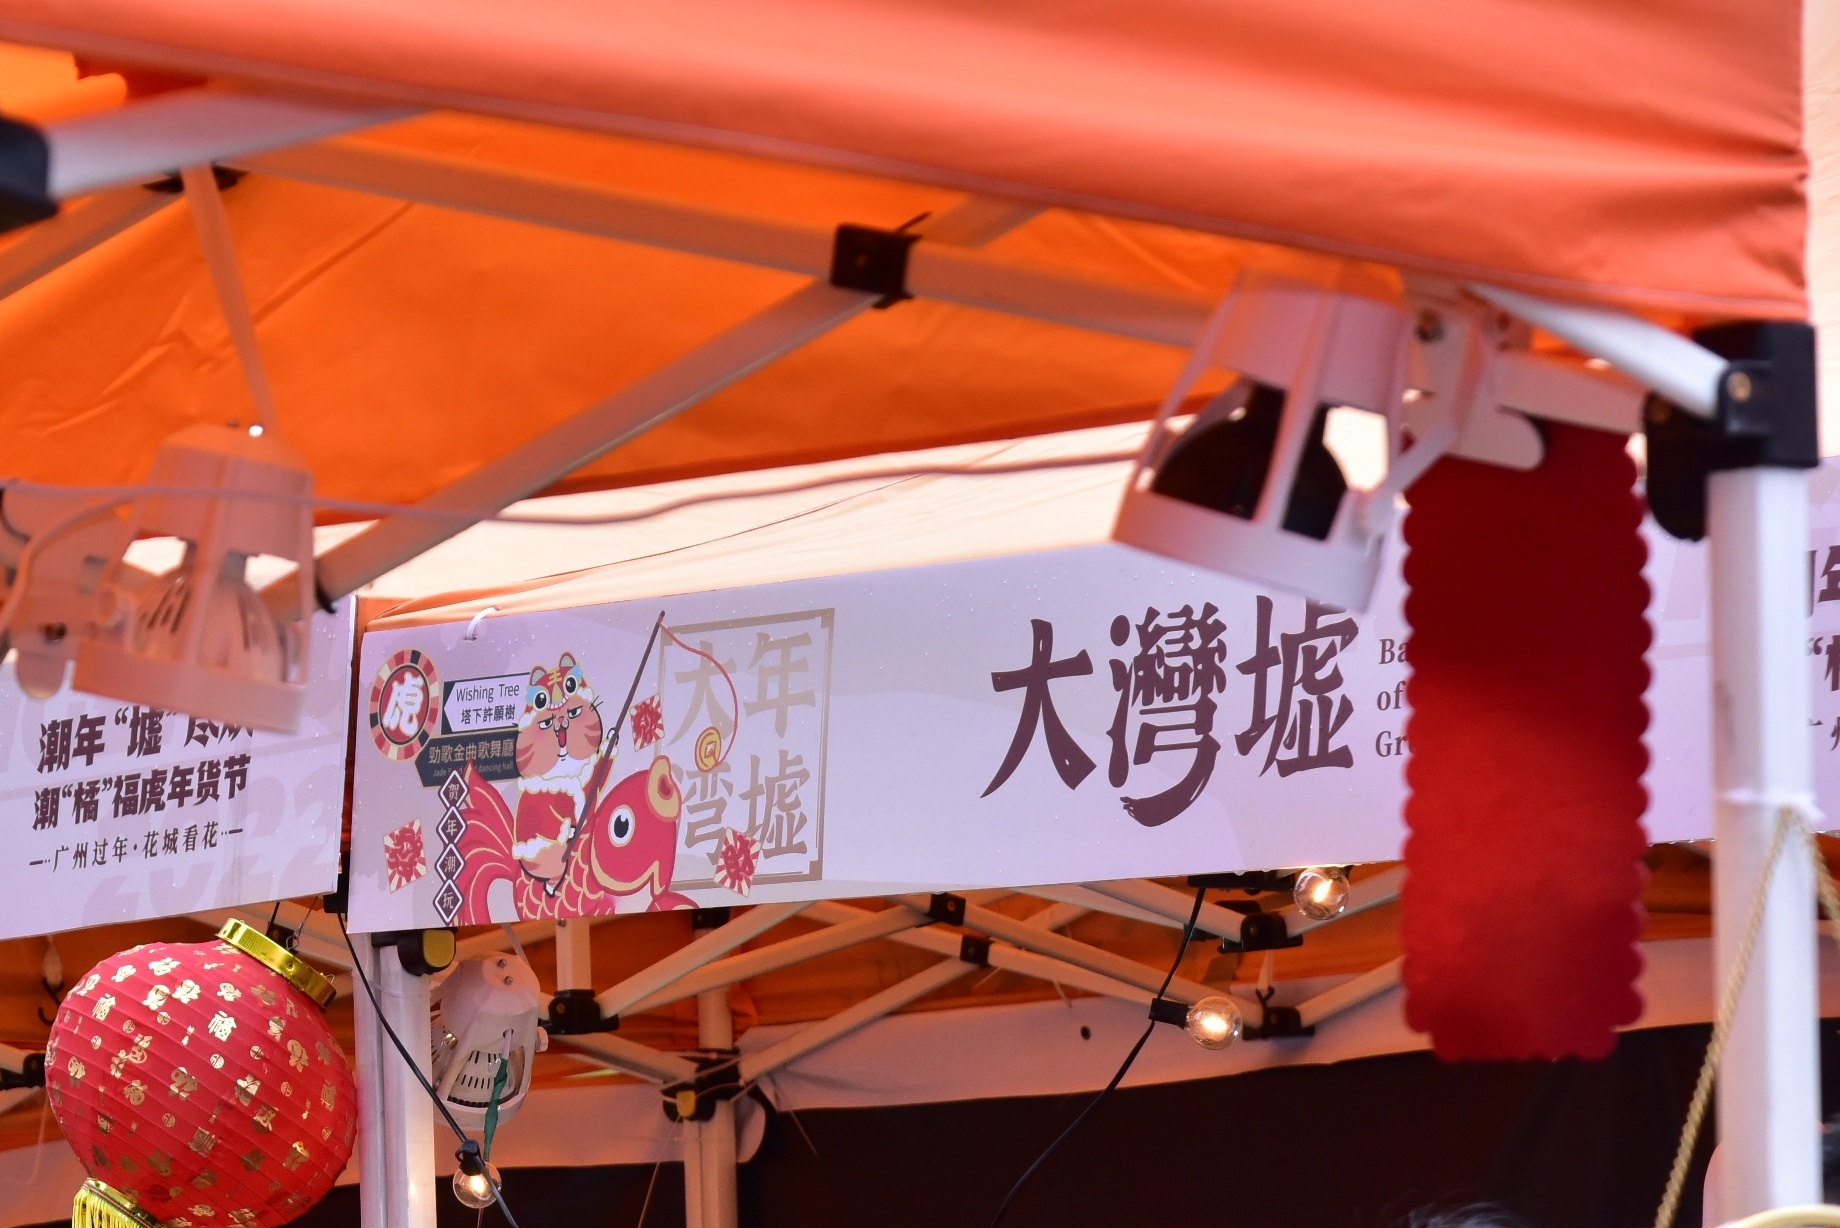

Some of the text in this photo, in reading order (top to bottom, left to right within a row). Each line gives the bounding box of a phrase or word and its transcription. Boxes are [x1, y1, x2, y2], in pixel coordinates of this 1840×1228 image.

[382, 671, 424, 736] 虎
[456, 684, 520, 702] Wishing Tree
[1377, 681, 1406, 711] of
[461, 704, 516, 724] 塔下許願樹
[980, 594, 1360, 827] 大灣墟
[429, 739, 516, 764] 勁歌金曲歌舞廳
